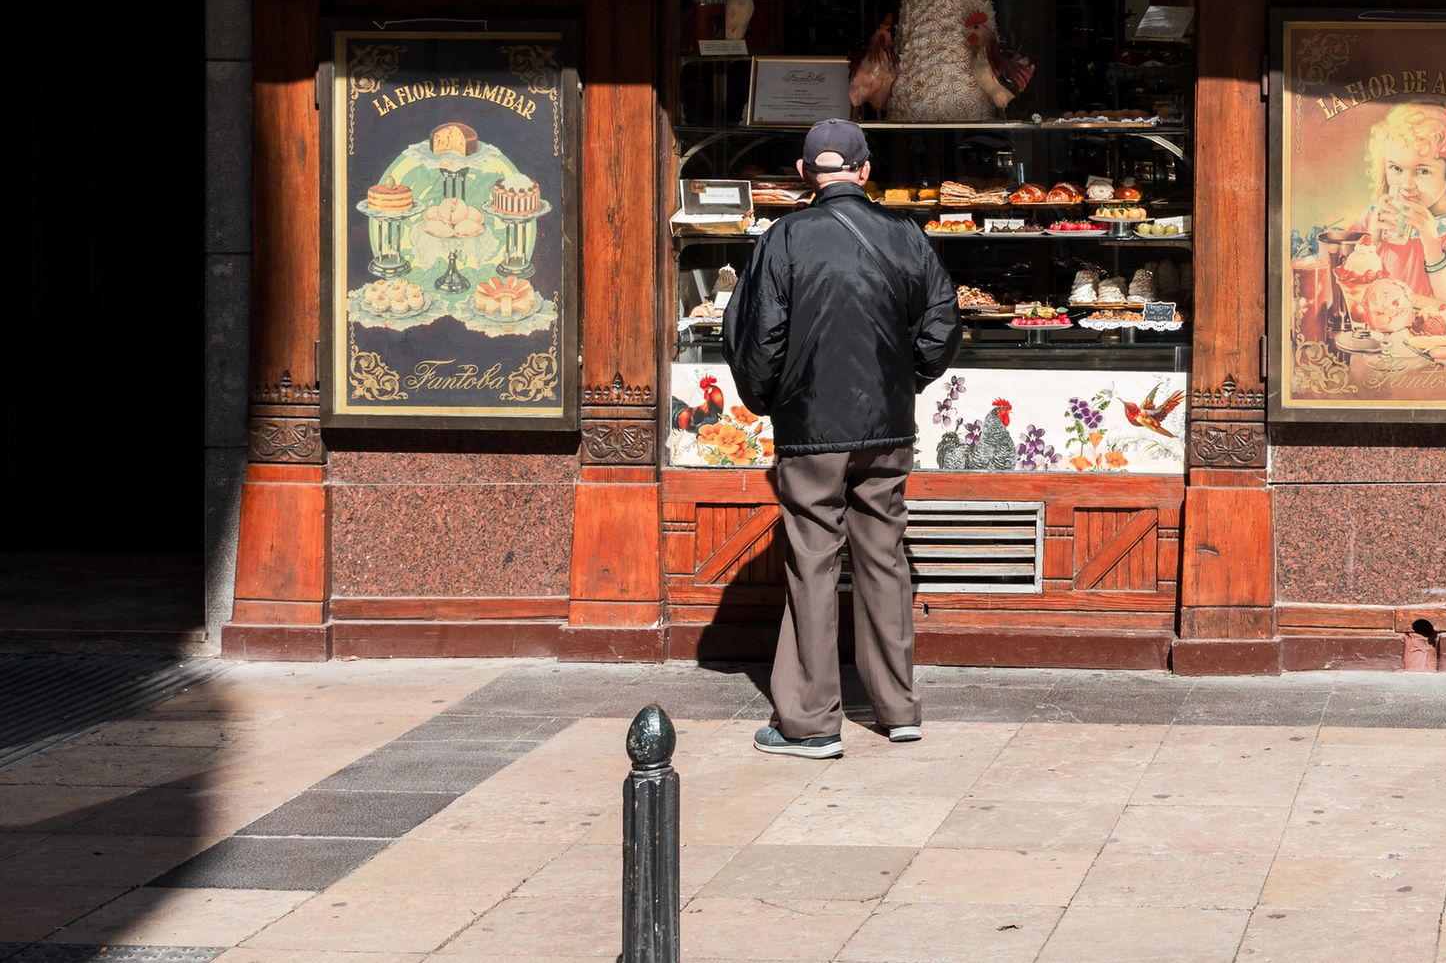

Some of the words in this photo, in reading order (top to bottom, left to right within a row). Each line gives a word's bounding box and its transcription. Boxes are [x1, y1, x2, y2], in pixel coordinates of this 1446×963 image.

[372, 94, 398, 116] LA
[394, 80, 437, 107] FLOR
[439, 77, 460, 96] DE
[462, 78, 537, 120] ALMIBAR
[1317, 92, 1350, 120] LA
[1345, 73, 1399, 107] FLOR
[1402, 70, 1428, 94] DE
[402, 358, 505, 393] Fantoba
